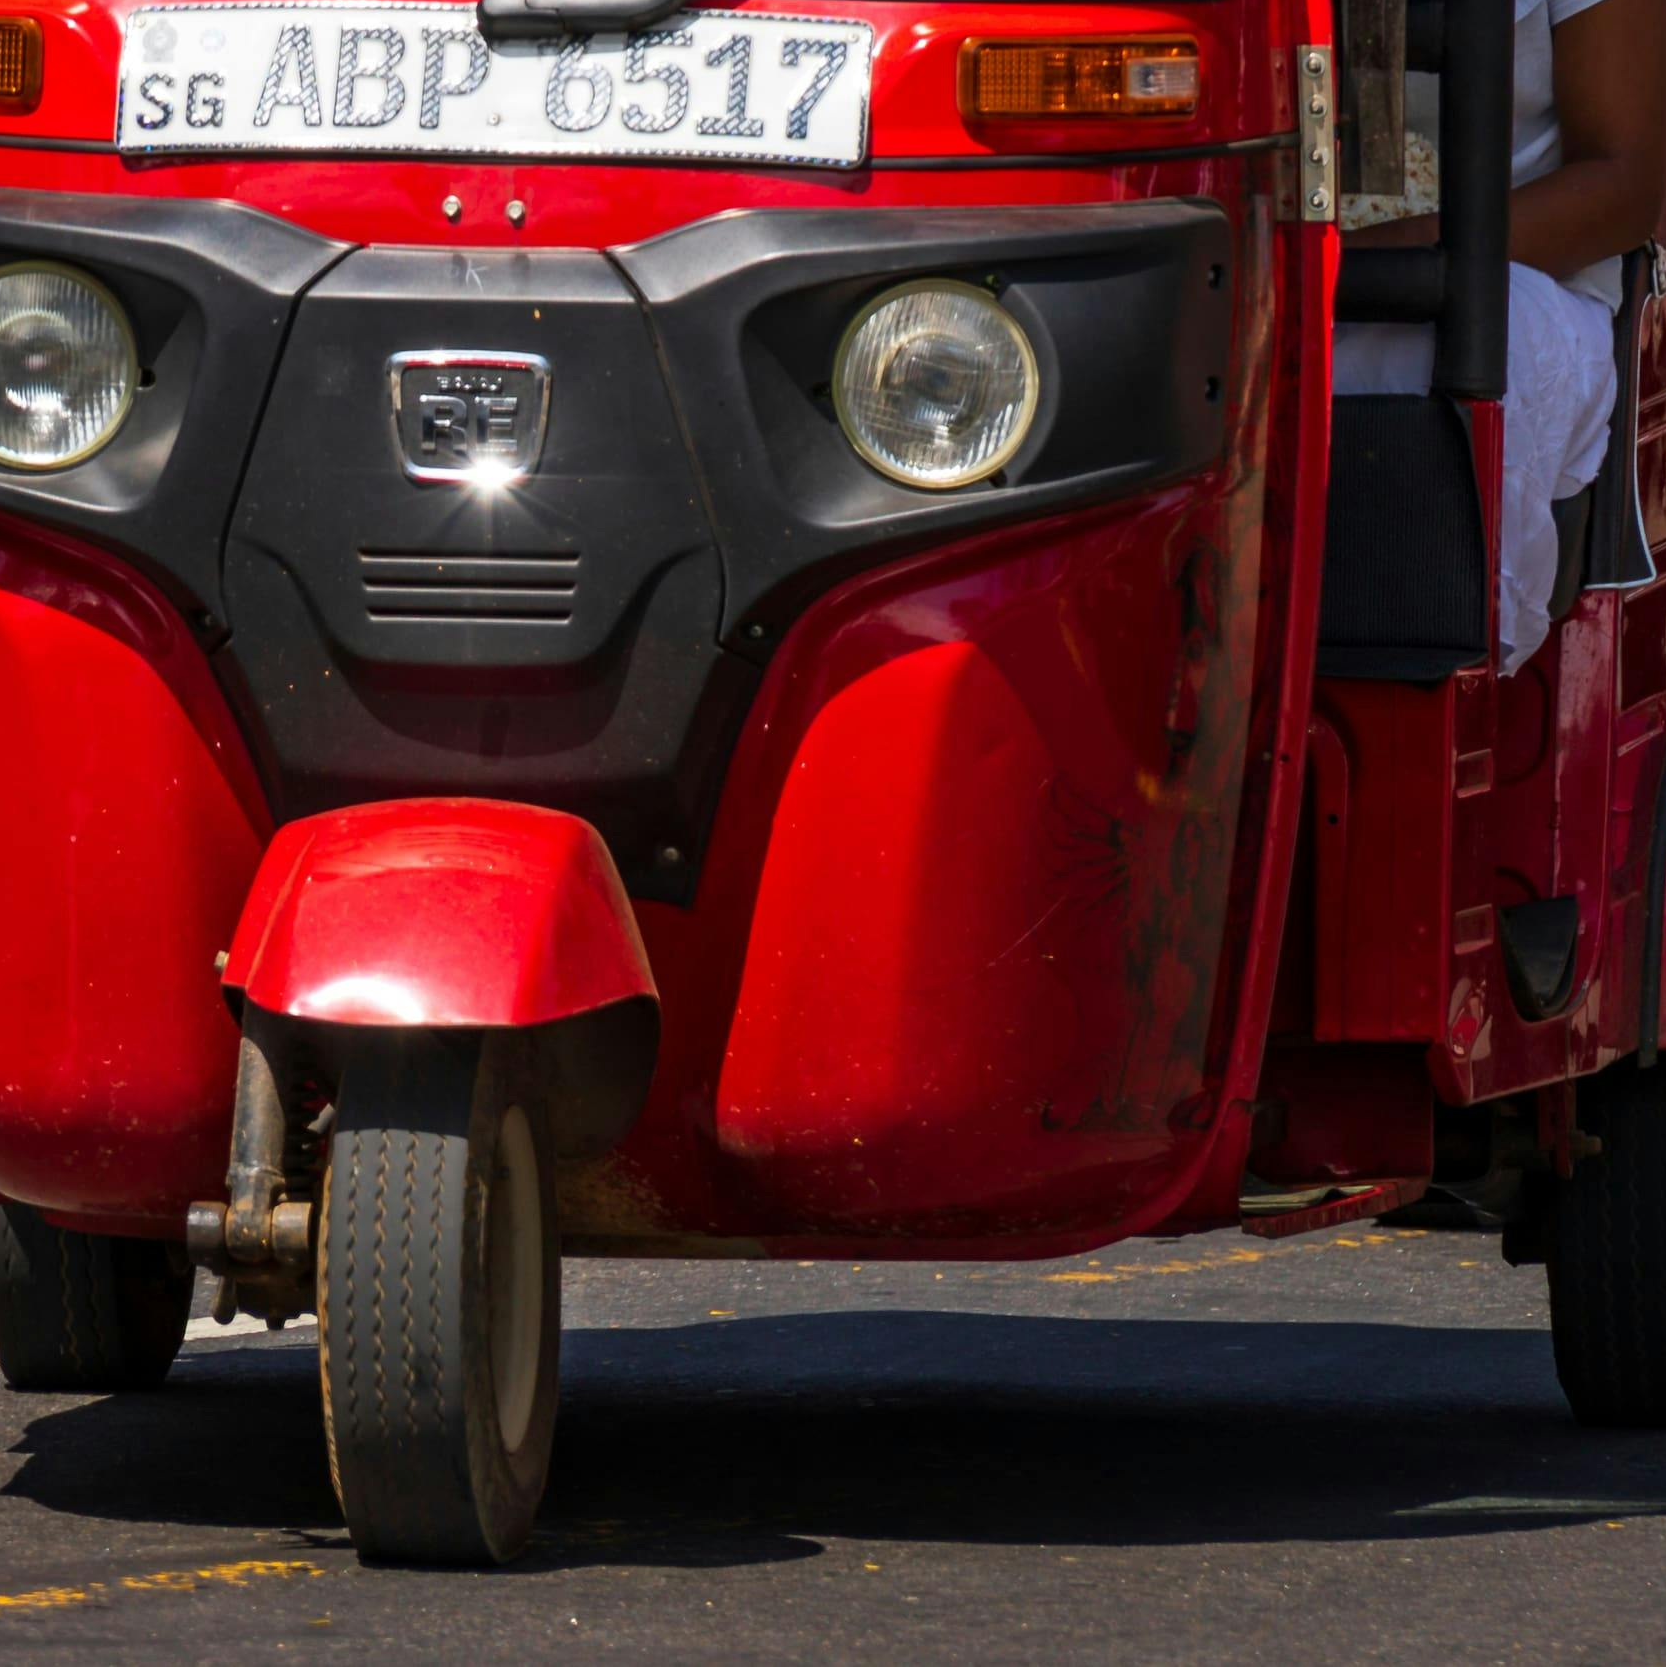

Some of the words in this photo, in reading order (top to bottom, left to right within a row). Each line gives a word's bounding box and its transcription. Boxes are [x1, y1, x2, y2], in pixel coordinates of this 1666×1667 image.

[134, 74, 225, 130] SG
[252, 23, 491, 129] ABP
[544, 29, 848, 140] 6517
[419, 393, 519, 453] RE
